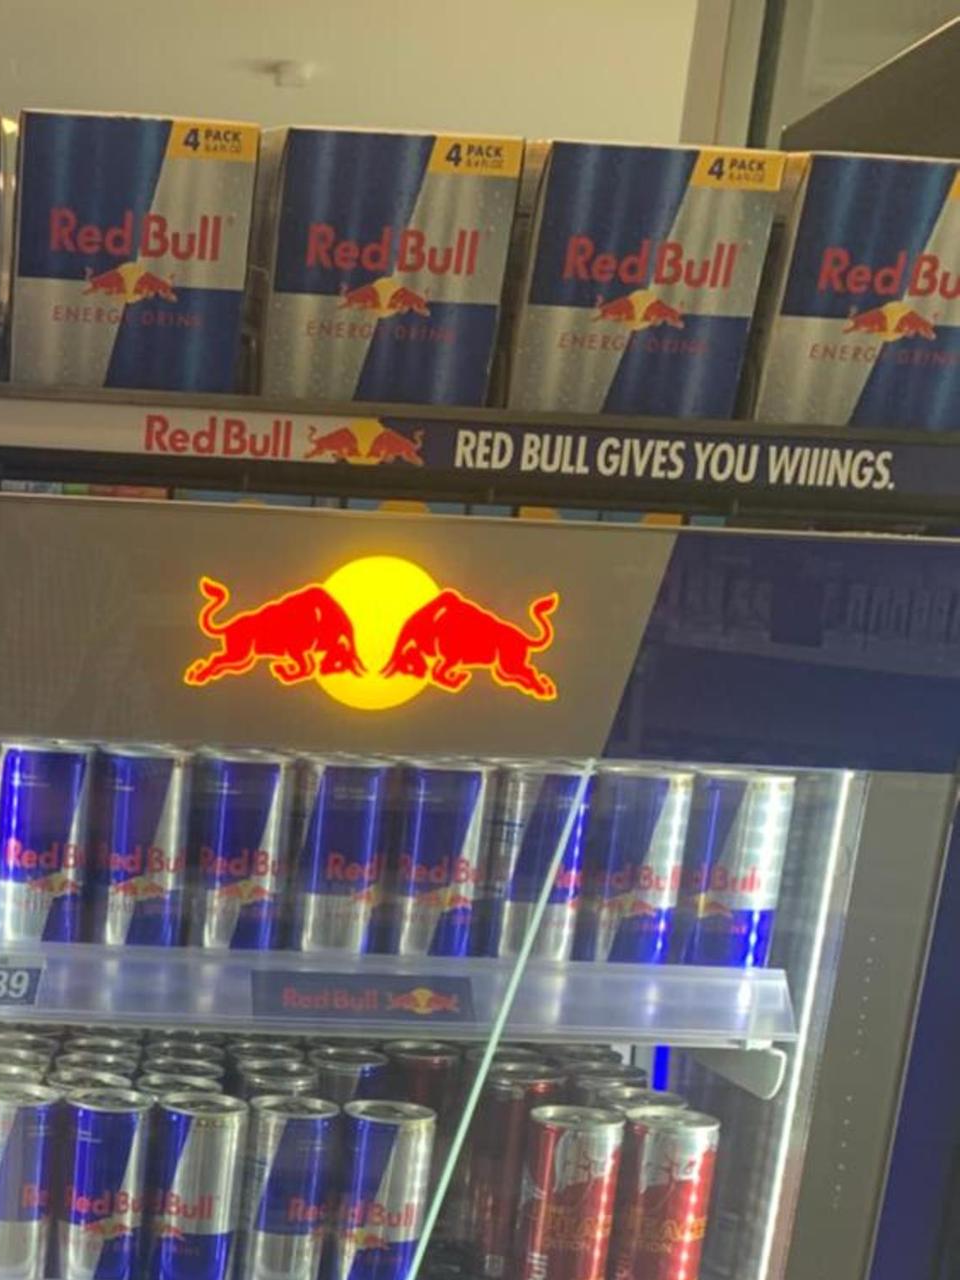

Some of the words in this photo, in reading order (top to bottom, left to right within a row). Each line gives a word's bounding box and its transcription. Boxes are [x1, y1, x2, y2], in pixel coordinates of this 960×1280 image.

[182, 127, 200, 151] 4
[205, 129, 242, 143] PACK
[445, 143, 462, 167] 4
[467, 144, 503, 158] PACK
[730, 158, 766, 172] PACK
[708, 157, 724, 181] 4
[49, 206, 133, 258] Red
[141, 213, 222, 263] Bull
[305, 224, 390, 272] Red
[397, 229, 480, 277] Bull
[562, 235, 649, 286] Red
[653, 240, 737, 290] Bull
[817, 245, 906, 297] Red
[144, 413, 216, 455] Red
[221, 417, 292, 459] Bull
[455, 428, 515, 471] RED
[520, 433, 590, 475] BULL
[596, 437, 685, 481] GIVES
[693, 441, 763, 483] YOU
[767, 445, 896, 491] WIIINGS.
[5, 836, 58, 868] Red
[282, 987, 331, 1010] Red
[333, 988, 378, 1012] Bull
